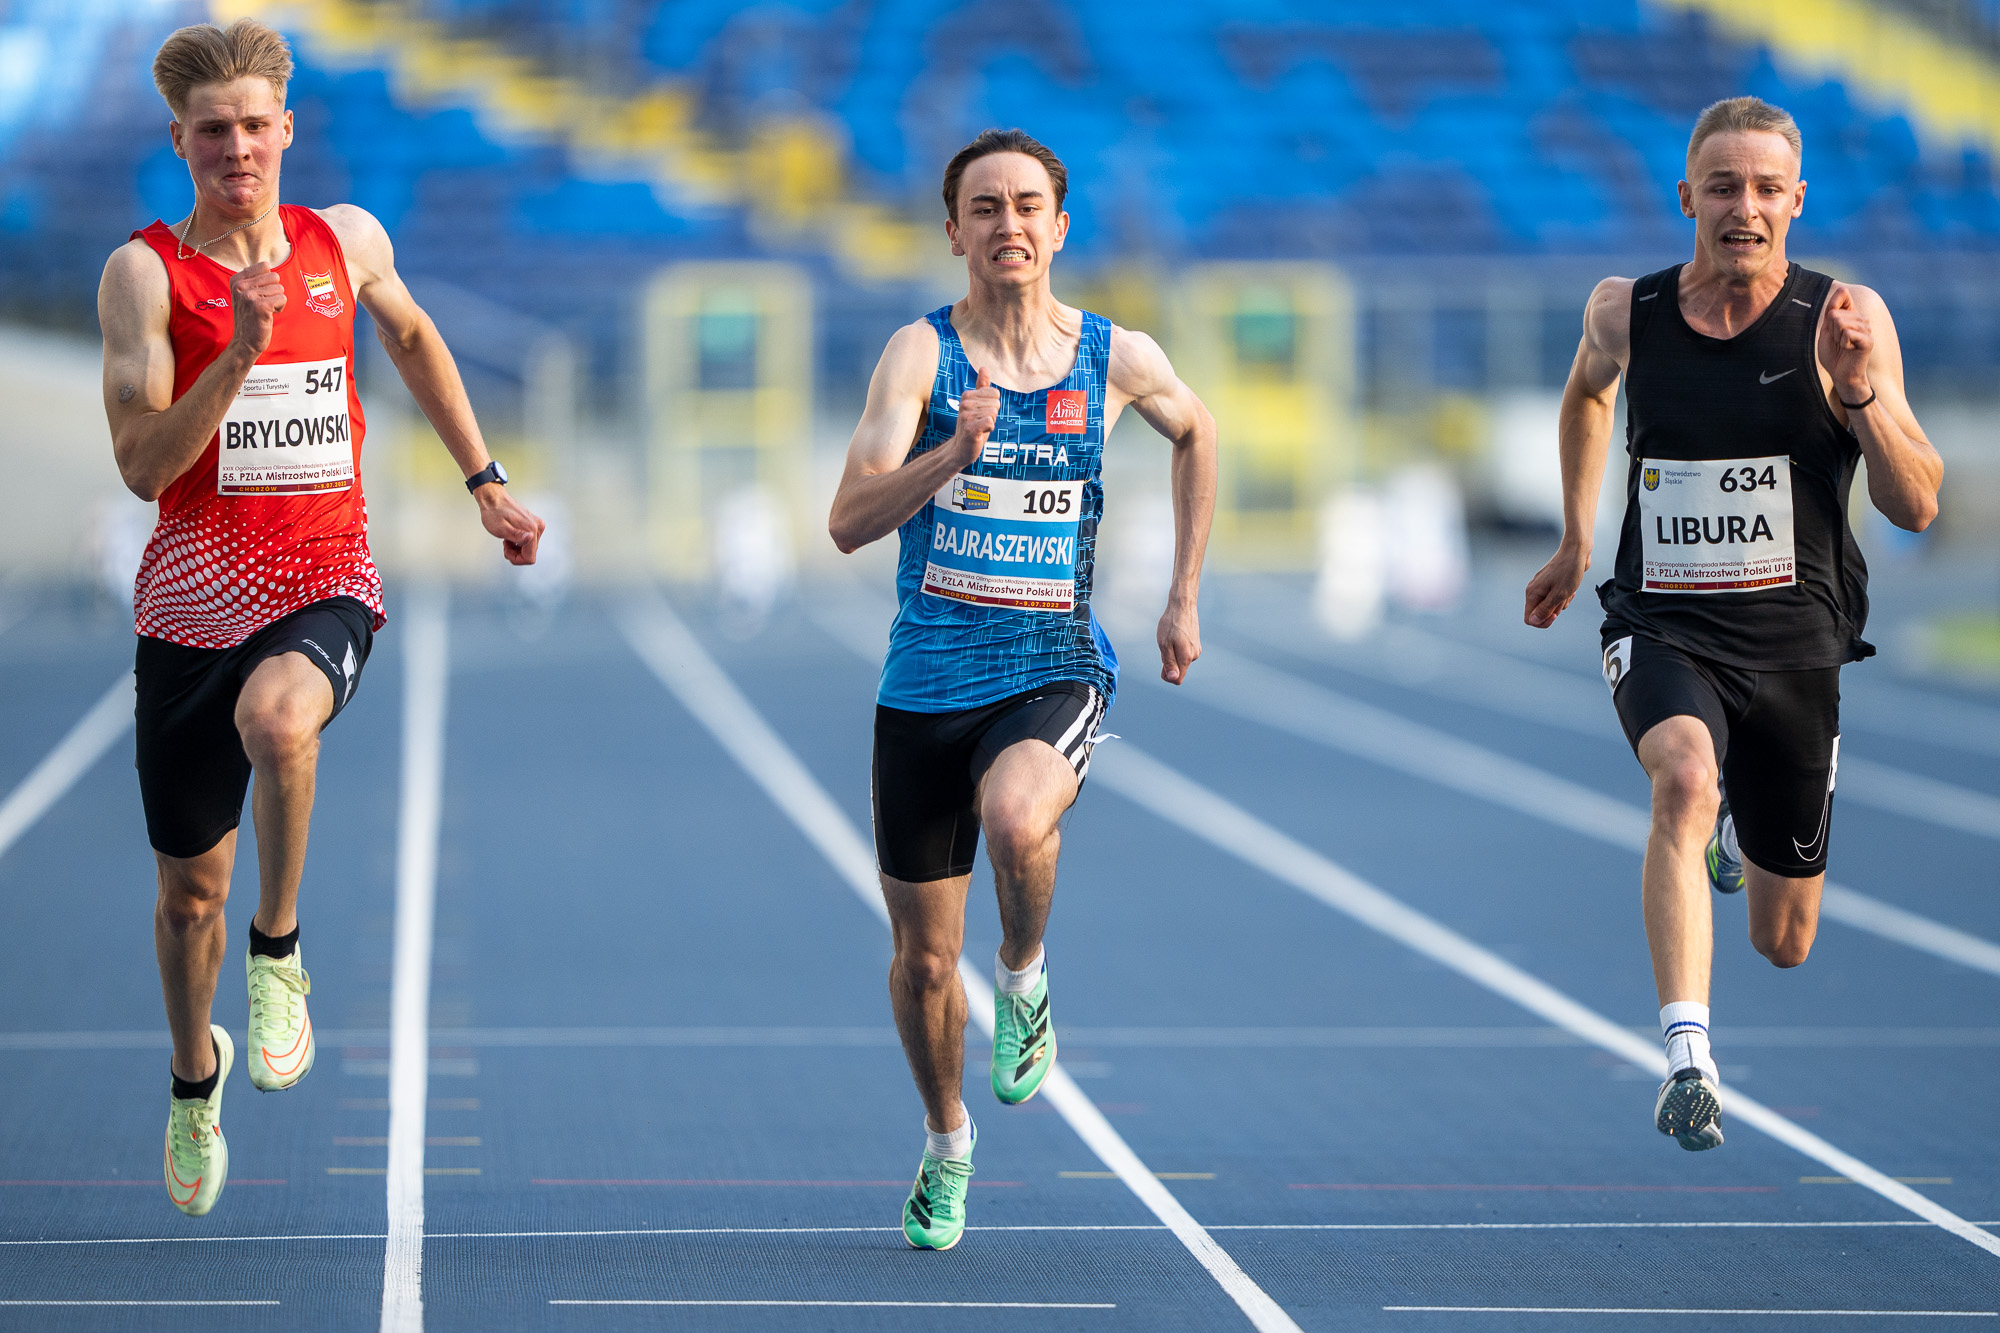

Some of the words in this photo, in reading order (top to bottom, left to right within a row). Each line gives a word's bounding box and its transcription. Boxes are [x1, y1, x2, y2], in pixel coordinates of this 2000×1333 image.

[266, 383, 289, 391] Turystyki
[305, 366, 342, 394] 547
[1050, 400, 1083, 418] Anwil
[226, 413, 349, 449] BRYLOWSKI
[222, 472, 237, 482] 55.
[240, 472, 263, 481] PZLA
[265, 471, 320, 481] Mistrzostwa
[321, 467, 342, 477] Polski
[1664, 470, 1702, 478] Województwo
[1664, 478, 1683, 486] Śląskie
[1719, 465, 1777, 493] 634
[1023, 489, 1072, 515] 105
[1656, 514, 1775, 545] LIBURA
[933, 522, 1074, 566] BAJRASZEWSKI
[1645, 567, 1657, 577] 55.
[1659, 568, 1680, 578] PZLA
[1683, 568, 1740, 578] Mistrzostwa
[1743, 564, 1771, 576] Polski
[1774, 562, 1792, 573] U18
[926, 571, 938, 582] 55.
[942, 575, 964, 588] PZLA
[967, 581, 1023, 595] Mistrzostwa
[1026, 587, 1054, 597] Polski
[1056, 588, 1073, 598] U18
[940, 589, 977, 601] CHORZÓW
